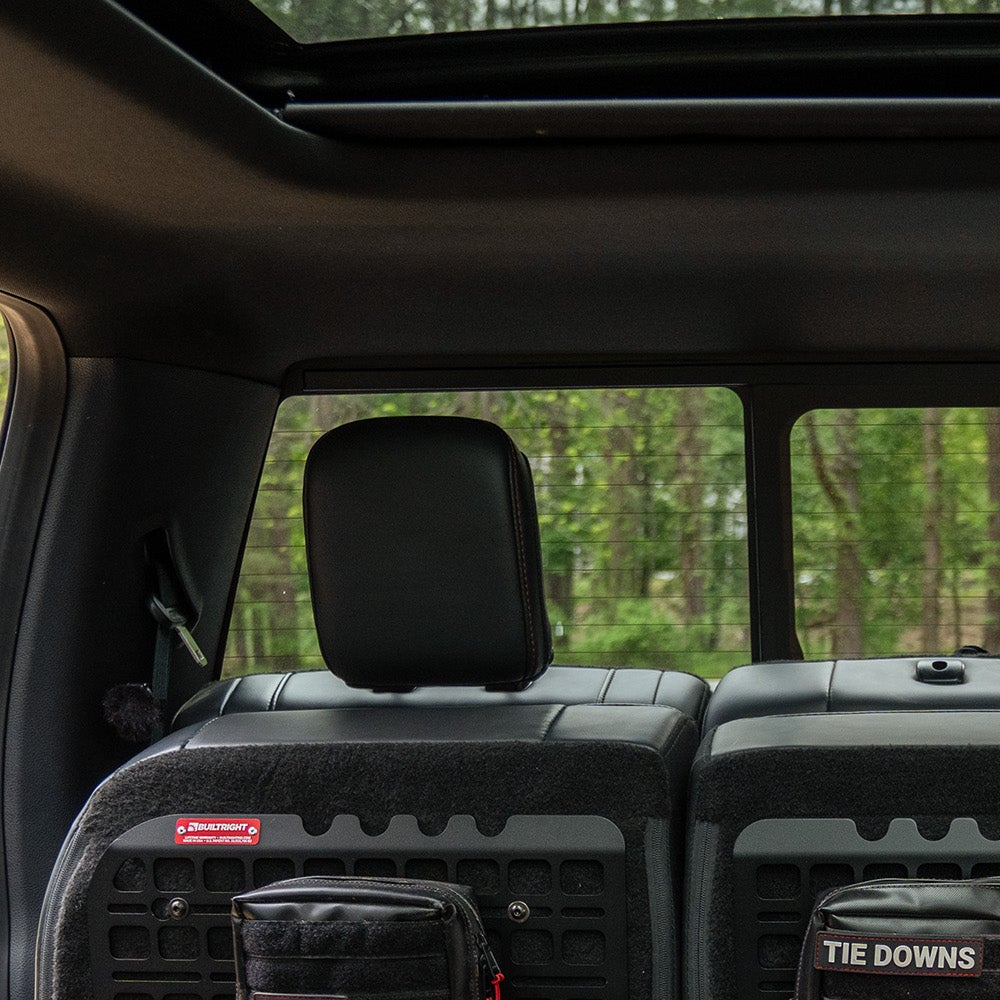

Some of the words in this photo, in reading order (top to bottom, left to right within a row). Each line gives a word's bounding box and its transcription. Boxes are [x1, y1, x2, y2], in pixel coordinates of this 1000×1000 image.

[197, 823, 248, 831] BUILTRIGHT
[823, 940, 868, 966] TIE
[873, 944, 976, 970] DOWNS
